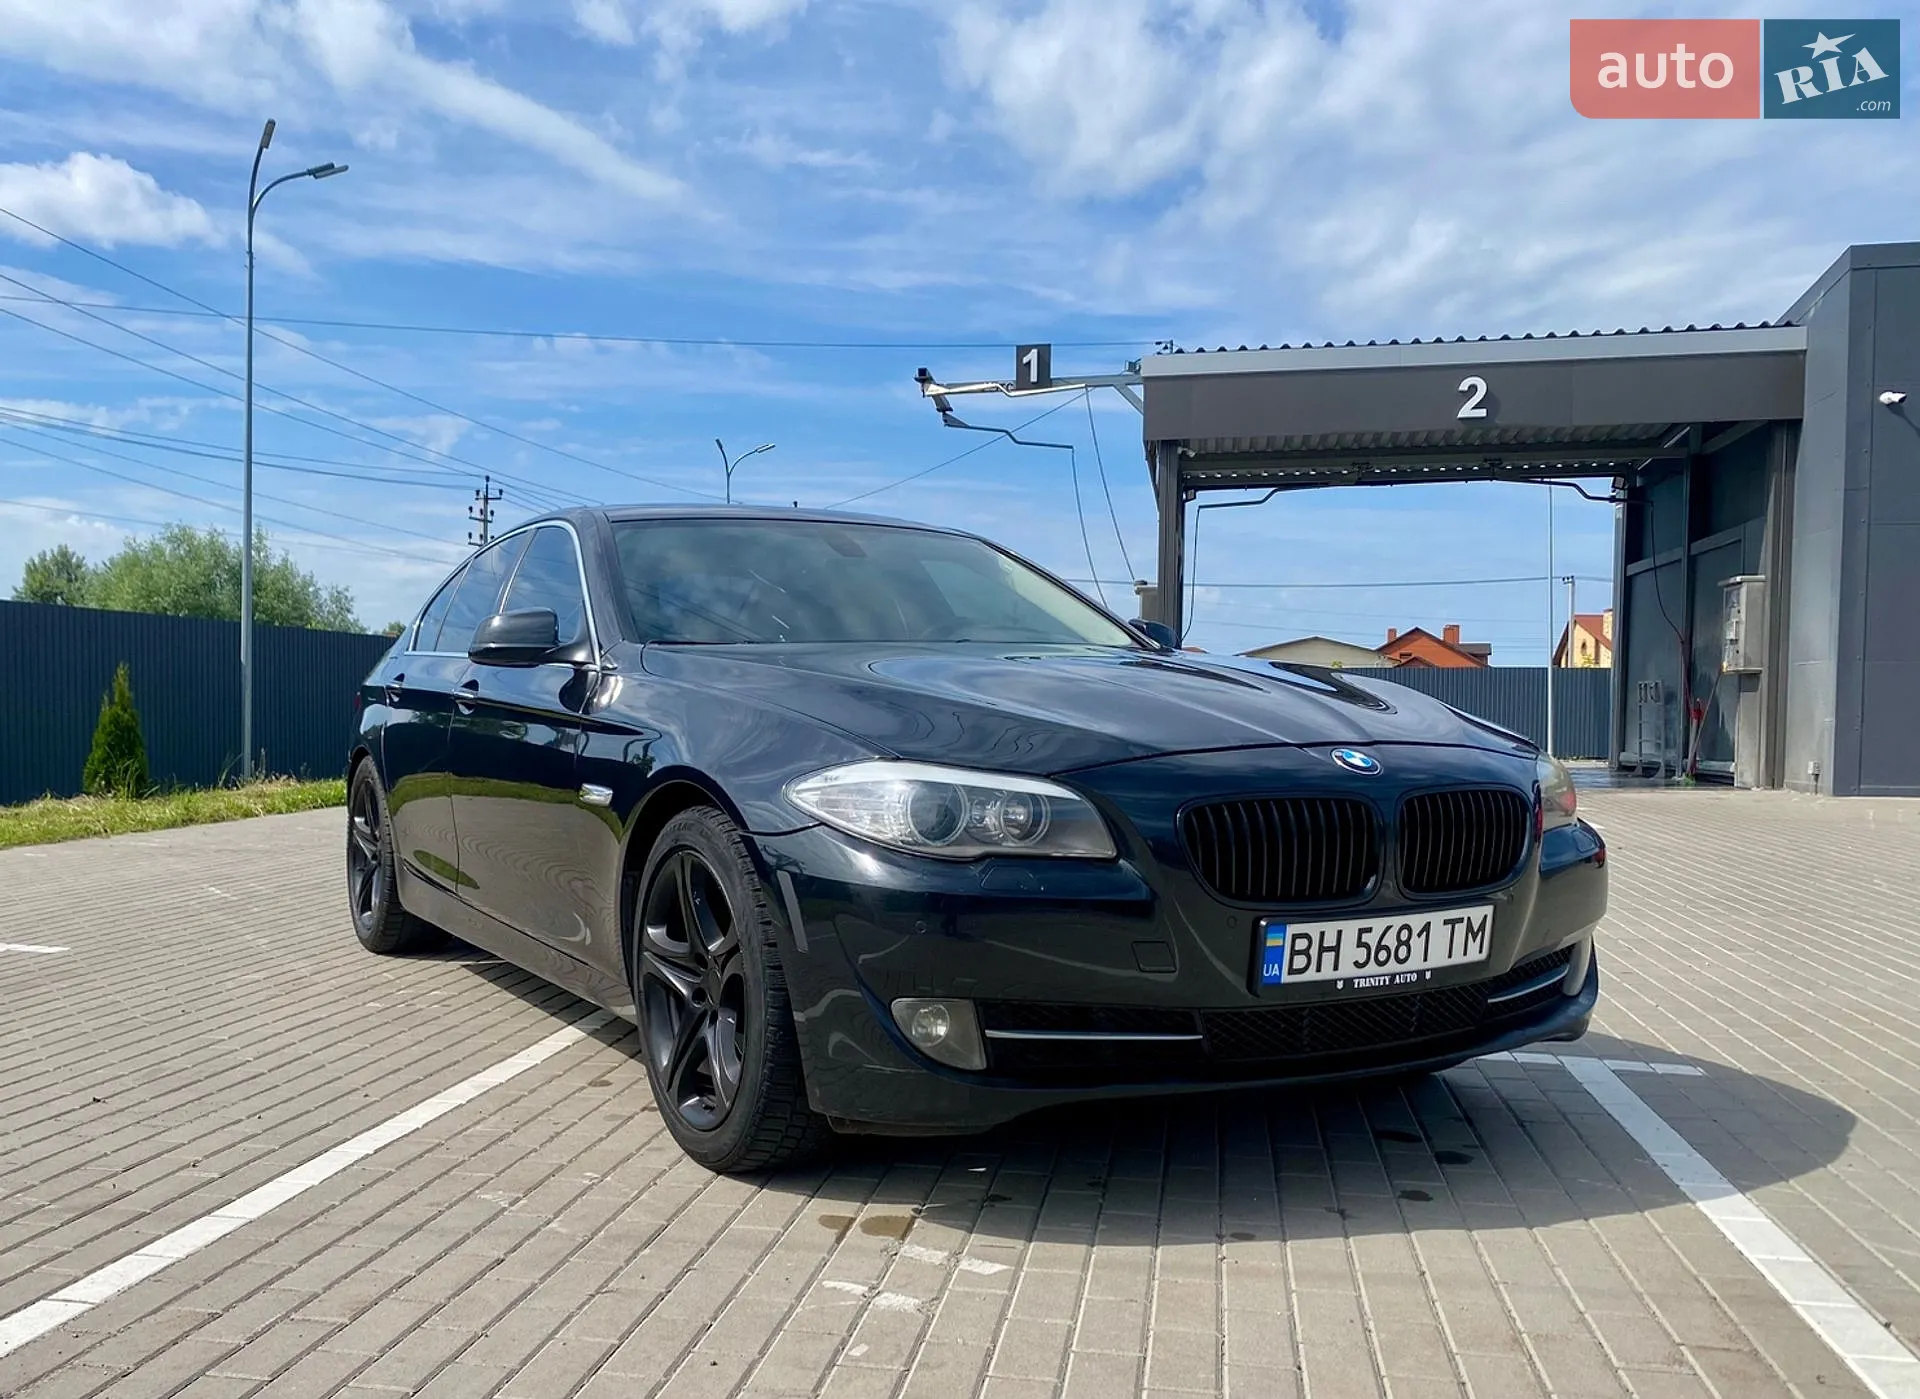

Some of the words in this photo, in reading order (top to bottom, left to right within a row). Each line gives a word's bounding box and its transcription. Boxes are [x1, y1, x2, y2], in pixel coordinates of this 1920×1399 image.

[1022, 348, 1039, 382] 1
[1457, 376, 1488, 418] 2
[1287, 929, 1343, 976] BH
[1353, 921, 1432, 969] 5681
[1443, 914, 1488, 959] TM
[1263, 963, 1280, 977] UA
[1353, 975, 1391, 988] TRINITY
[1394, 972, 1418, 985] AUTO
